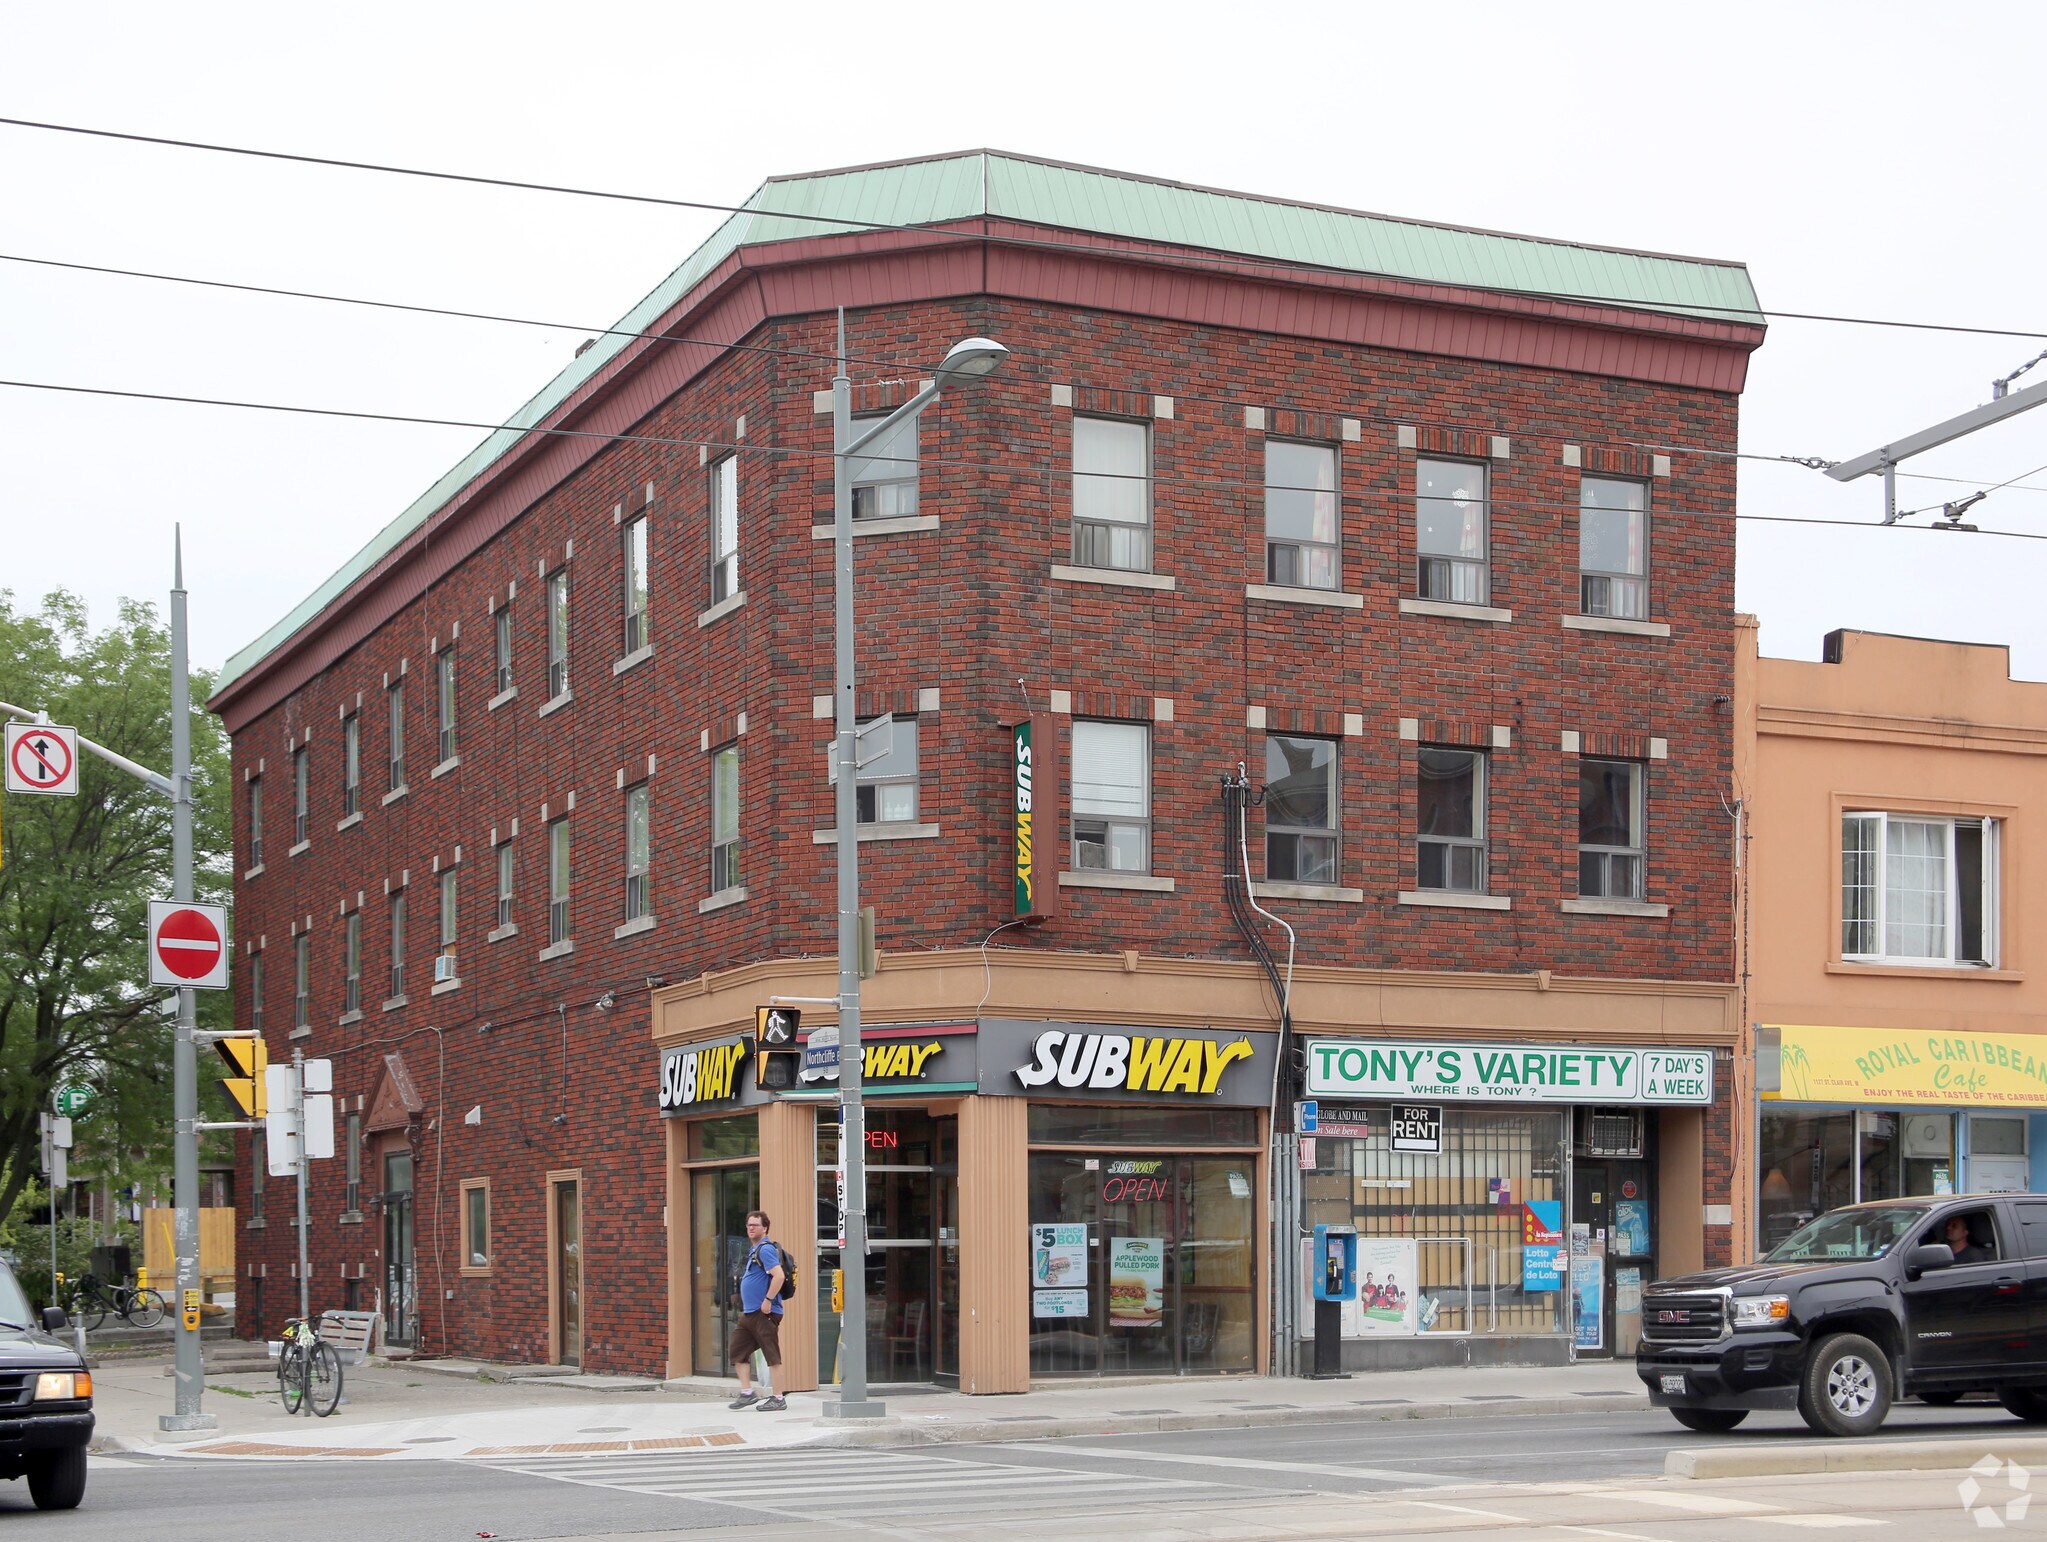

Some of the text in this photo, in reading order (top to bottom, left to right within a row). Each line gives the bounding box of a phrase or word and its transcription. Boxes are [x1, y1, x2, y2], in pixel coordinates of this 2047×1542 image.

[1016, 735, 1032, 900] SUBWAY
[806, 1049, 836, 1065] Northcliffe
[1013, 1030, 1254, 1094] SUBWAY
[1855, 1042, 1921, 1080] ROYAL
[658, 1038, 746, 1107] SUBWAY
[1315, 1048, 1632, 1086] TONY'S VARIETY
[1650, 1057, 1704, 1074] 7 DAY'S
[1934, 1064, 1987, 1092] Cafe
[1411, 1085, 1537, 1097] WHERE IS TONY ?
[1648, 1079, 1704, 1095] A WEEK
[1864, 1089, 1893, 1097] ENJOY
[1896, 1089, 1914, 1097] THE
[1916, 1090, 1940, 1098] REAL
[1943, 1091, 1970, 1099] TASTE
[1973, 1092, 1985, 1100] OF
[1987, 1092, 2005, 1100] THE
[70, 1092, 88, 1109] P
[1338, 1110, 1351, 1120] AND
[1352, 1111, 1368, 1121] MAIL
[1404, 1108, 1429, 1120] FOR
[1325, 1126, 1341, 1135] Sale
[1341, 1126, 1358, 1135] here
[1393, 1120, 1439, 1139] RENT
[864, 1131, 898, 1148] PEN
[1107, 1161, 1162, 1174] SUBWAY
[1103, 1178, 1168, 1202] OPEN
[1036, 1228, 1056, 1247] $5
[1056, 1234, 1083, 1245] BOX
[1526, 1249, 1549, 1257] Lotto
[1526, 1270, 1558, 1279] de Loto
[1051, 1305, 1065, 1313] $15
[1658, 1310, 1690, 1323] GMC
